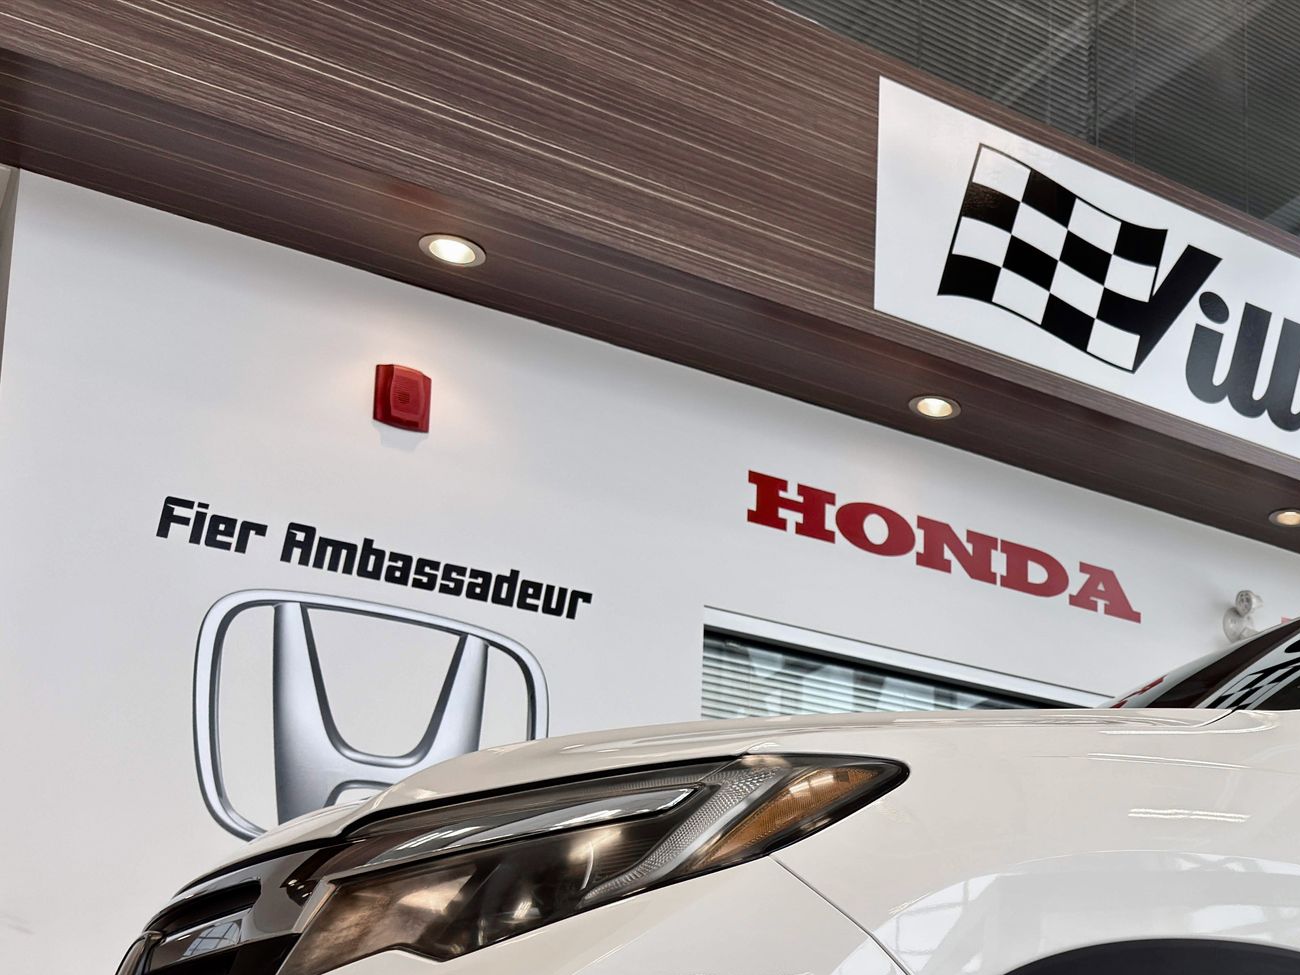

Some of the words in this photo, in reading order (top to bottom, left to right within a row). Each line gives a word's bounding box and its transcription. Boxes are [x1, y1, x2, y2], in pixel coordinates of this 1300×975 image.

[155, 495, 268, 554] Fier
[279, 521, 593, 620] Ambassadeur
[747, 470, 1141, 622] HONDA
